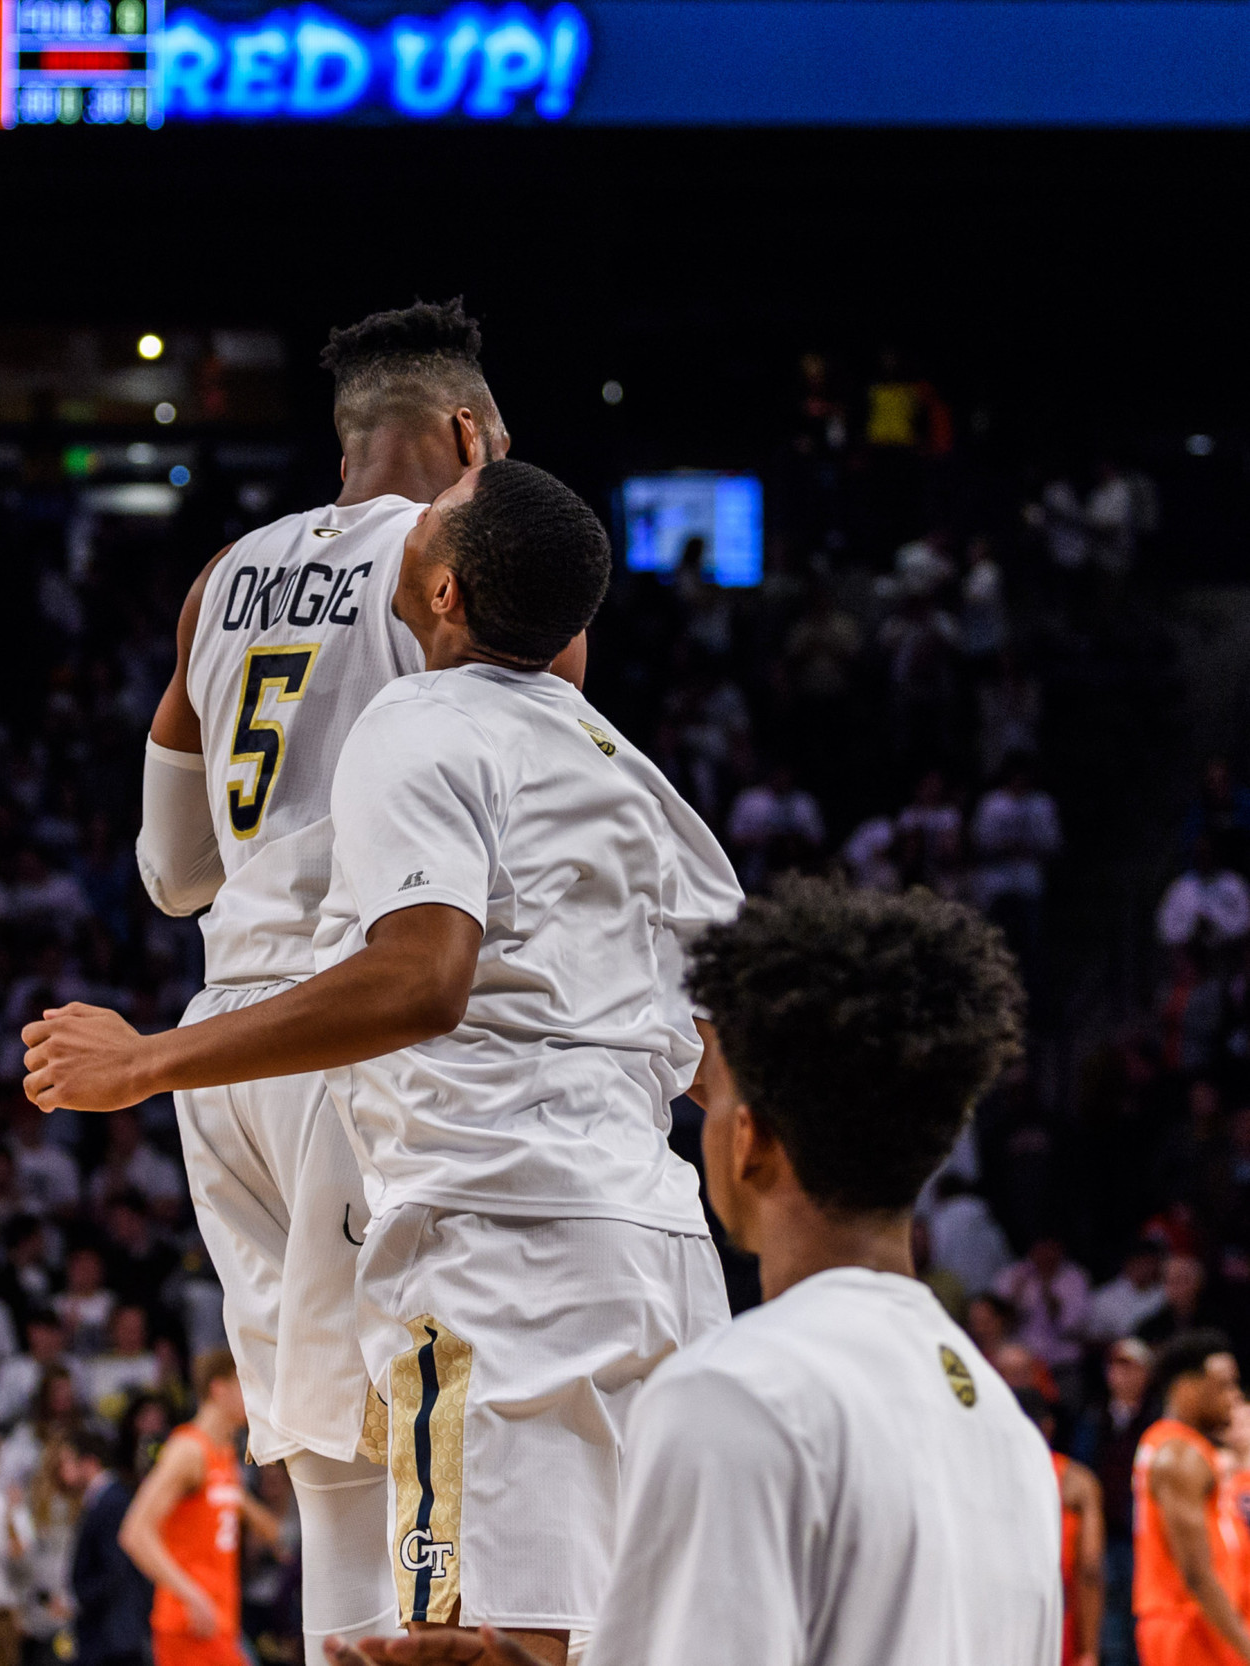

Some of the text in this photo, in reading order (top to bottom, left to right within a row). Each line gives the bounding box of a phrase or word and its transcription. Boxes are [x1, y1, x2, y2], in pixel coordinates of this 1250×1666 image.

[160, 12, 587, 118] RED UP!
[226, 642, 322, 841] 5
